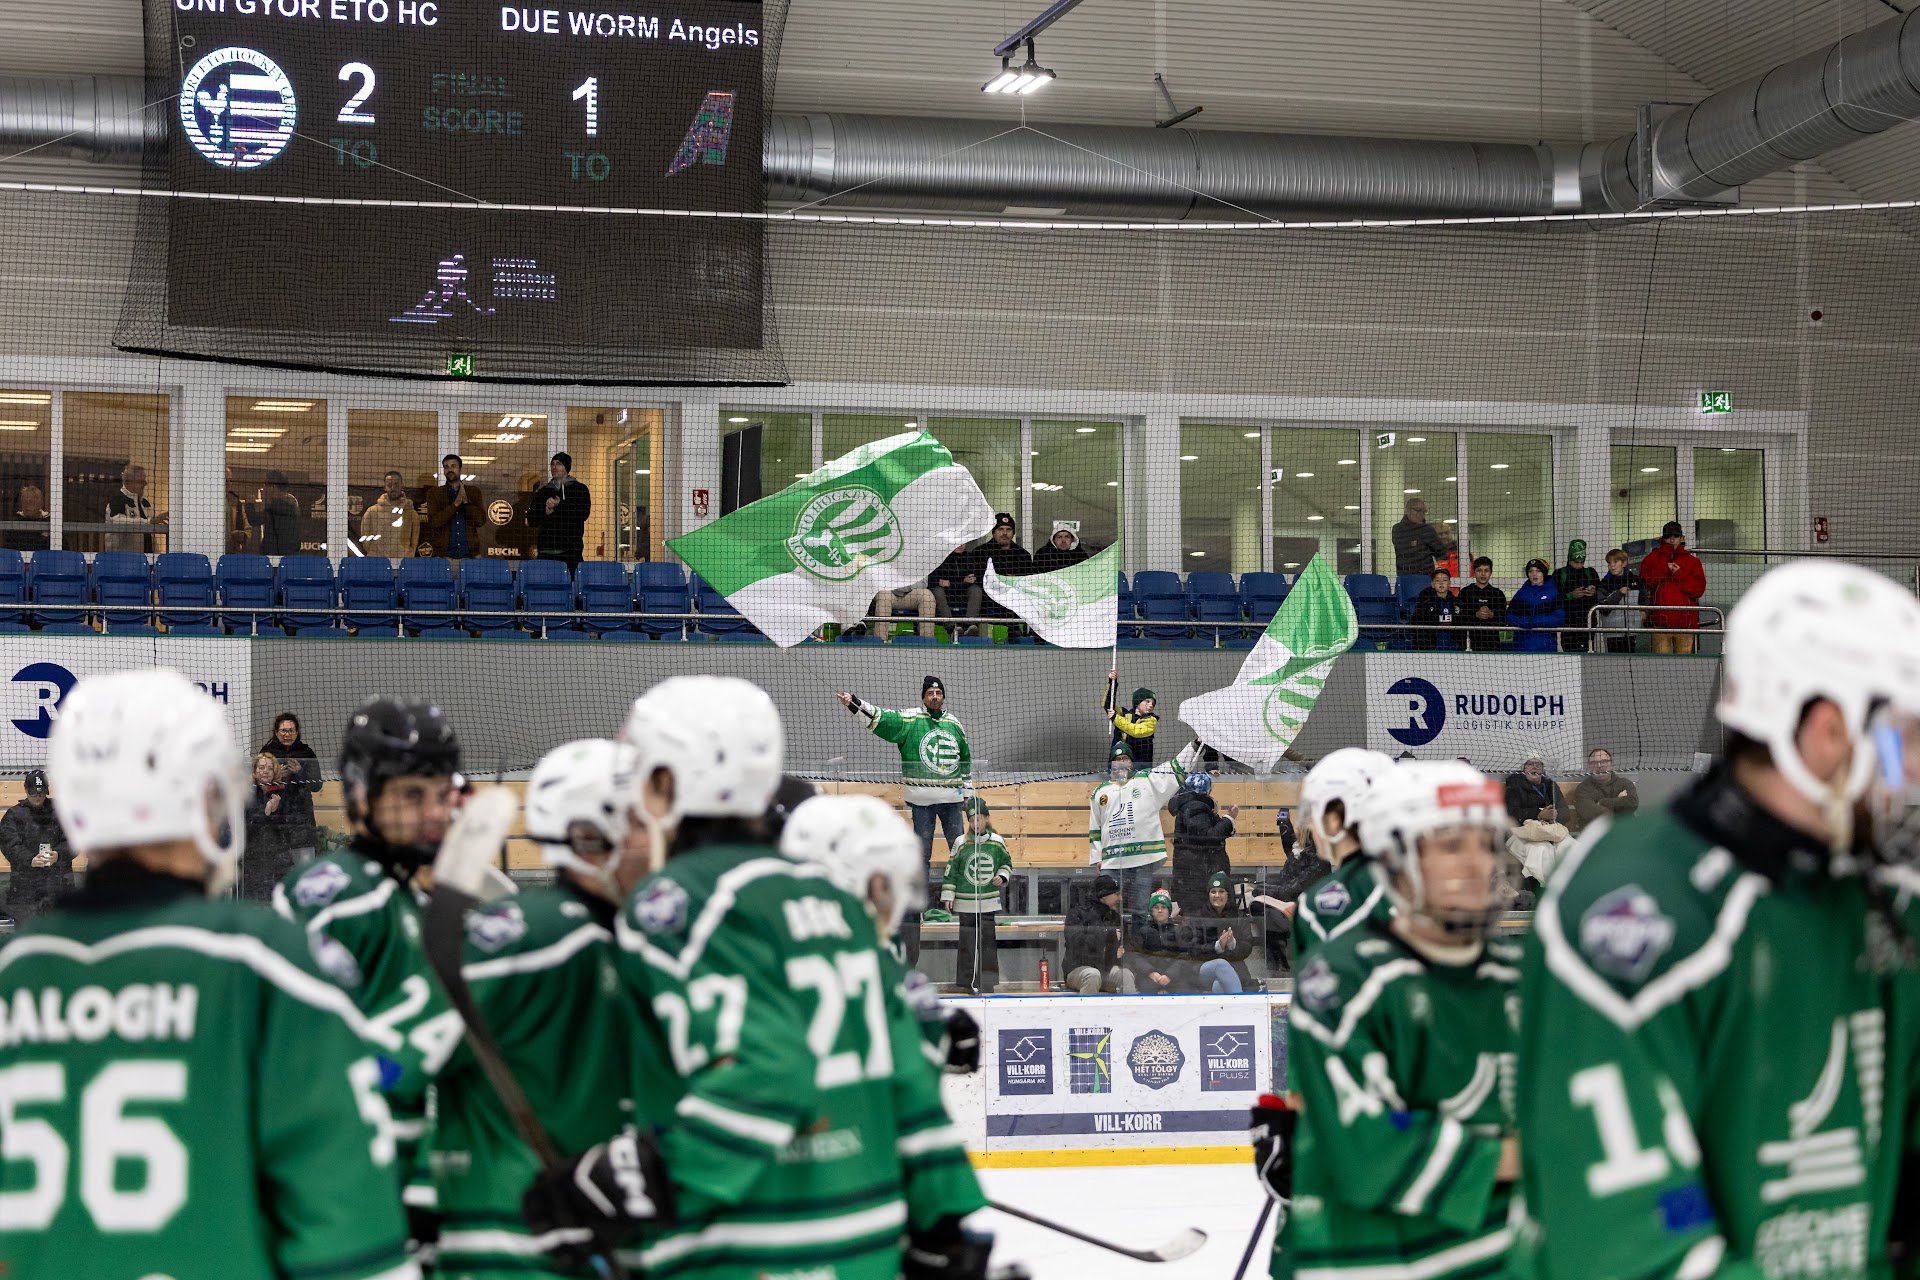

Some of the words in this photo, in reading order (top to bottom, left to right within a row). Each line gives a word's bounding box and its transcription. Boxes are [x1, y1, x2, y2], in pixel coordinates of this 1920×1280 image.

[330, 0, 389, 23] ETO
[398, 1, 438, 26] HC
[501, 7, 560, 34] DUE
[568, 11, 659, 39] WORM
[668, 18, 759, 50] Angels
[337, 61, 376, 124] 2
[572, 76, 597, 138] 1
[422, 106, 526, 135] SCORE
[329, 138, 378, 168] TO
[564, 152, 611, 181] TO
[1455, 694, 1564, 716] RUDOLPH
[1456, 720, 1512, 730] LOGISTIK
[1518, 720, 1564, 730] GRUPPE
[652, 973, 748, 1077] 27
[785, 949, 894, 1090] 27
[1007, 1064, 1046, 1075] VILL-KORR
[1134, 1064, 1150, 1073] HÉT
[1151, 1064, 1178, 1073] TÖLGY
[1208, 1058, 1249, 1069] VILL-KORR
[1094, 1113, 1162, 1132] VILL-KORR
[0, 1059, 189, 1233] 56
